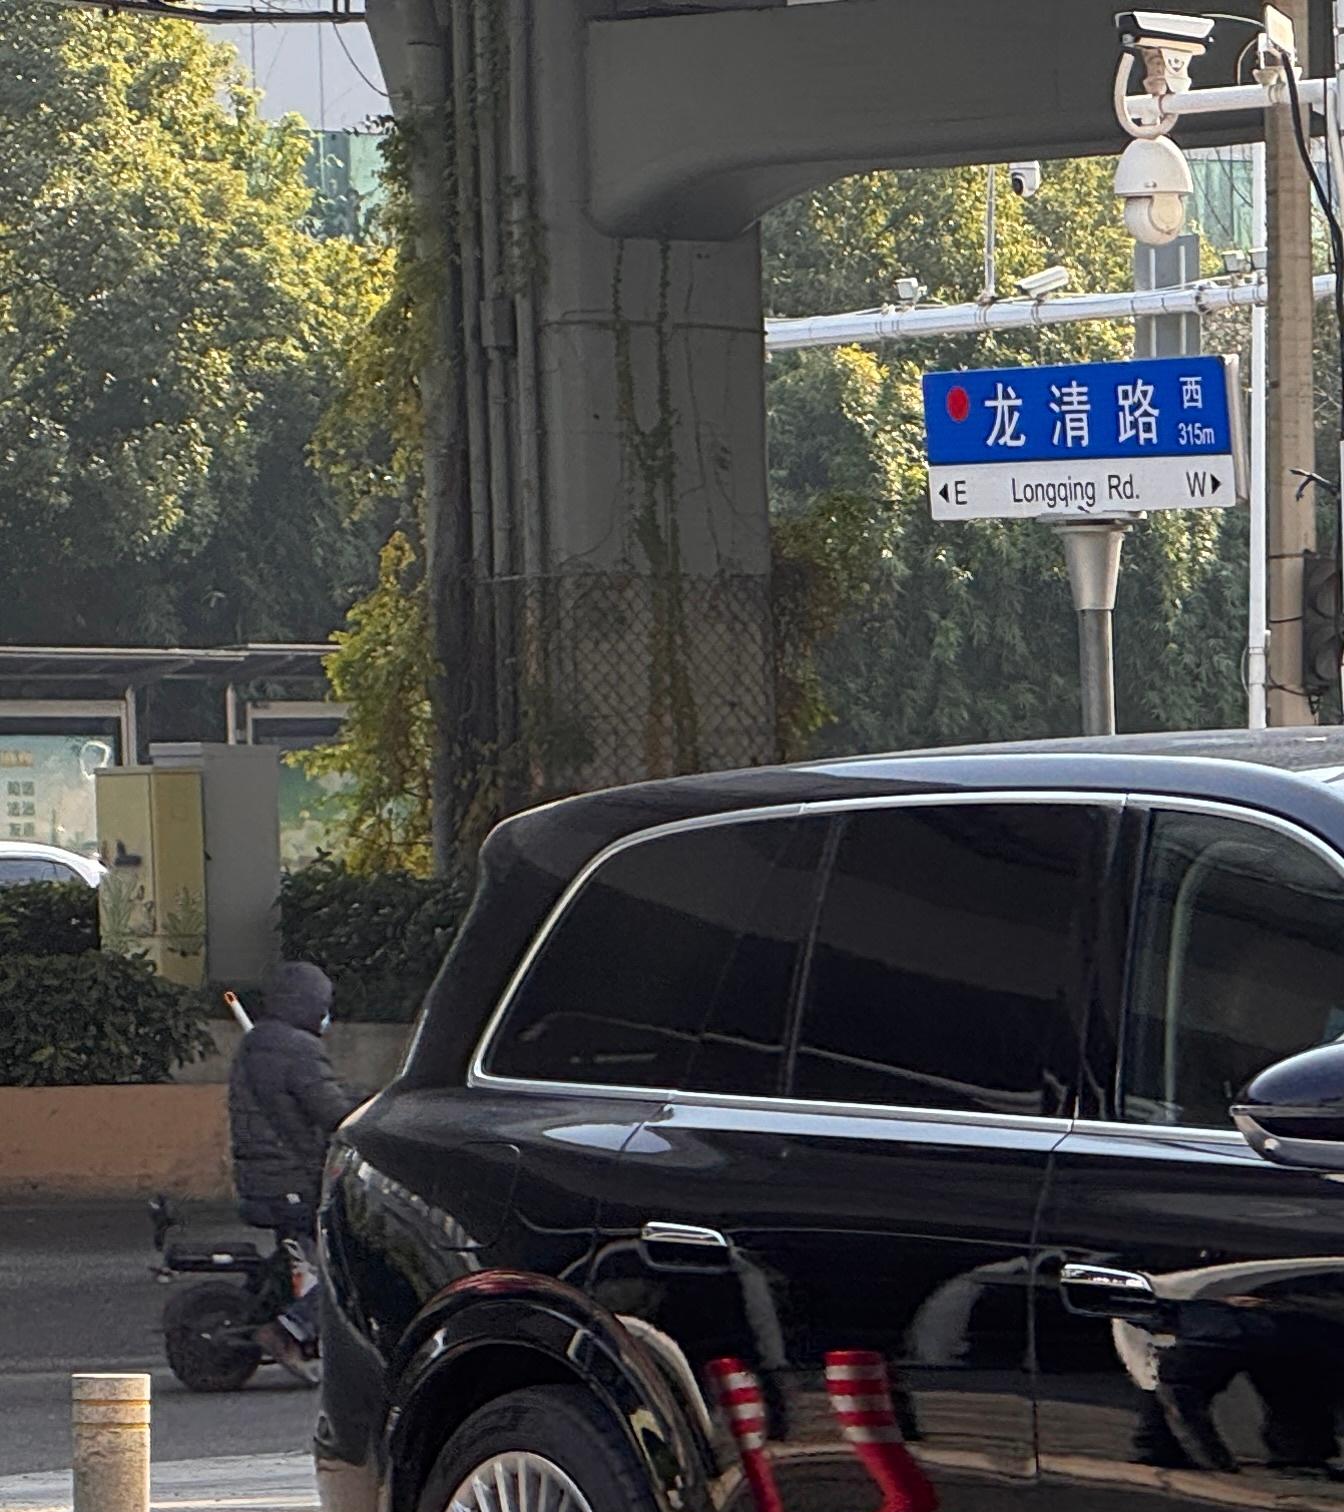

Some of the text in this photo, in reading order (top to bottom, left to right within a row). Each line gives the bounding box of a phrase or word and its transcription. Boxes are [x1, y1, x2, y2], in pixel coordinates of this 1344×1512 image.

[1179, 376, 1203, 409] 西
[984, 378, 1160, 448] 龙清路
[1178, 422, 1215, 446] 315m
[954, 480, 968, 506] E
[1011, 473, 1140, 507] Longqing Rd.
[1186, 471, 1207, 498] W
